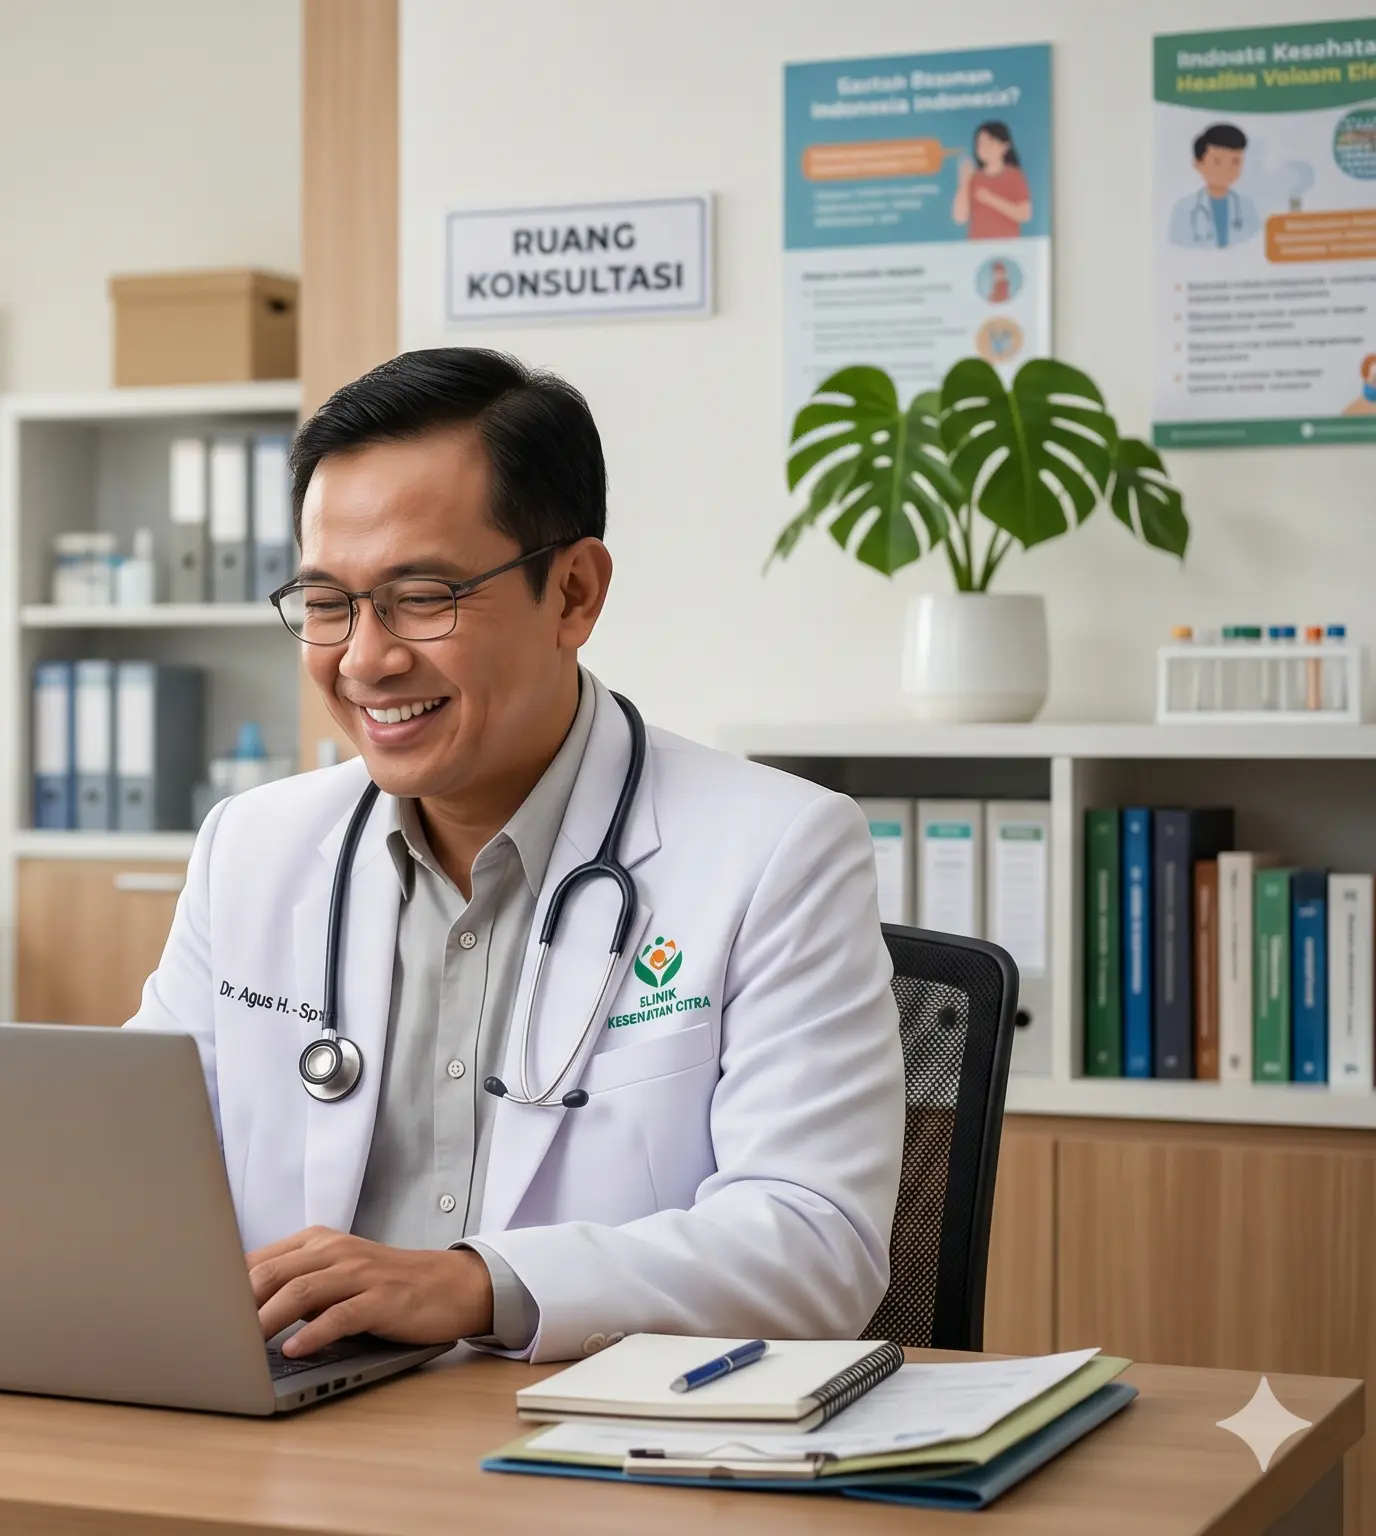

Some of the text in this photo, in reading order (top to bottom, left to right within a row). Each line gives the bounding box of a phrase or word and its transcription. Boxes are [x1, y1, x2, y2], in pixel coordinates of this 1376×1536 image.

[512, 221, 636, 257] RUANG
[466, 261, 684, 300] KONSULTASI
[219, 980, 235, 999] Dr.
[237, 986, 274, 1008] Agus
[276, 996, 290, 1014] H.
[675, 995, 711, 1013] CITRA
